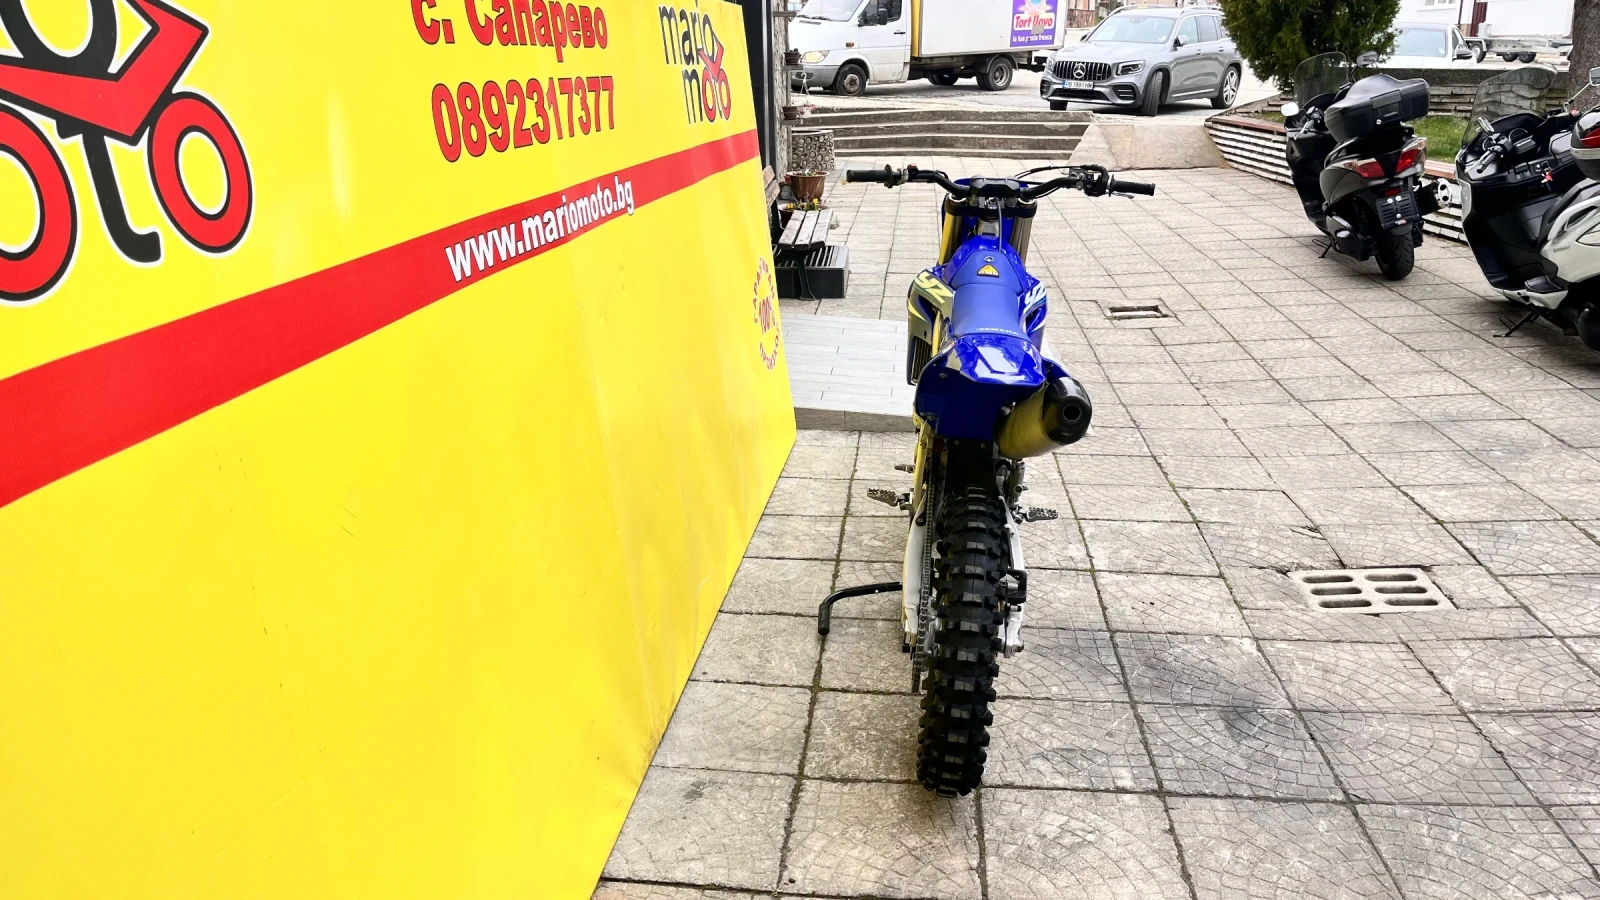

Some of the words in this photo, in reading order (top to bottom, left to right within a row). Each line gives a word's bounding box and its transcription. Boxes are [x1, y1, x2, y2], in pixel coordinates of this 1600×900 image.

[658, 0, 715, 65] mario
[431, 75, 615, 163] 0892317377
[682, 66, 731, 124] moto
[444, 175, 635, 283] www.mariomoto.bg
[915, 271, 953, 304] YZ
